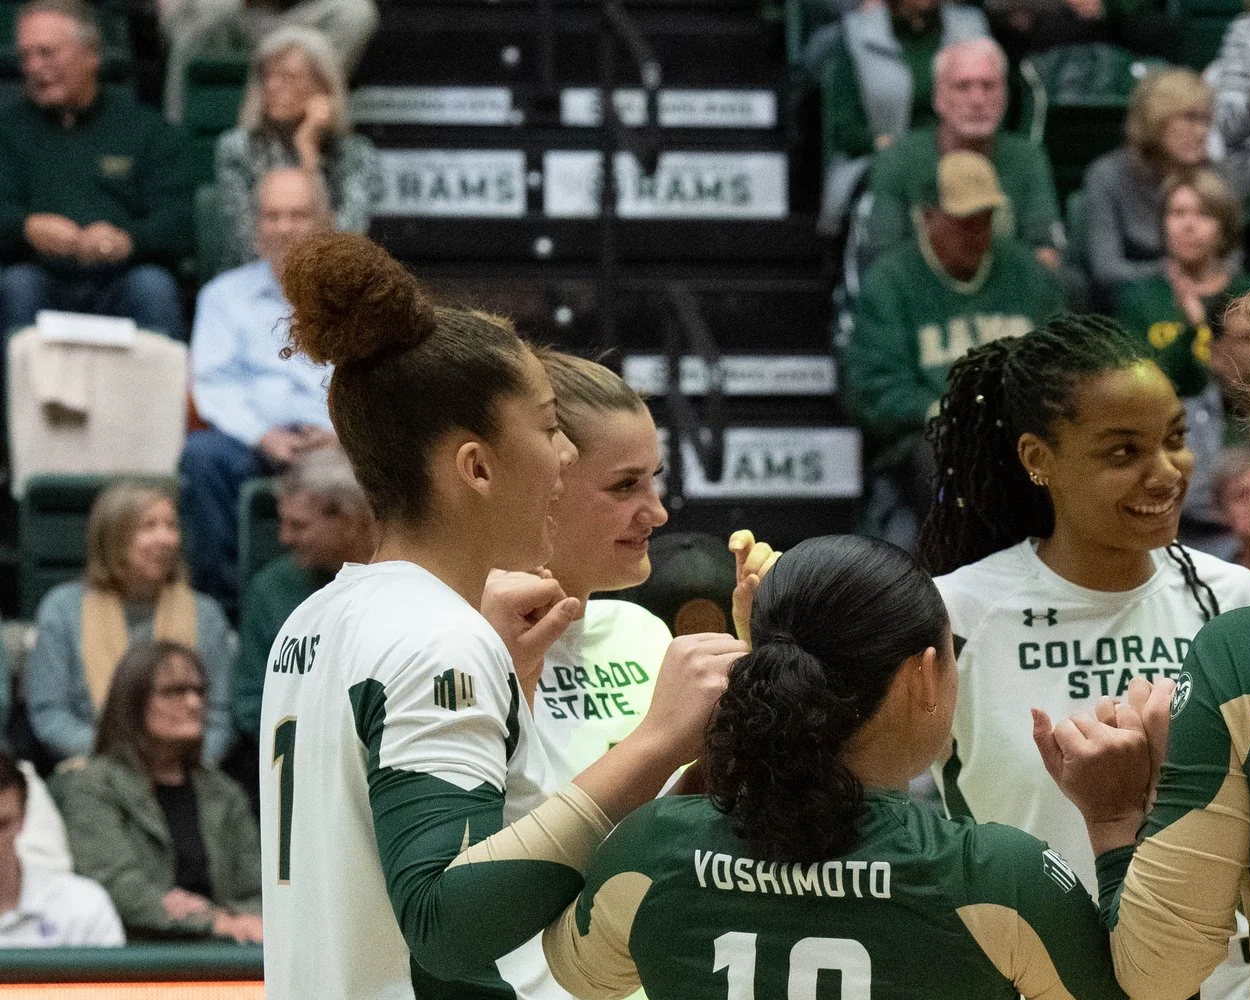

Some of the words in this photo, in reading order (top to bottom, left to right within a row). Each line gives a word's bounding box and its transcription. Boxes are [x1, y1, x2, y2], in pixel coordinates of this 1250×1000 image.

[731, 450, 824, 484] AMS
[1018, 635, 1193, 670] COLORAD
[536, 660, 650, 694] LORADO
[271, 714, 299, 886] 1
[694, 848, 892, 899] YOSHIMOTO
